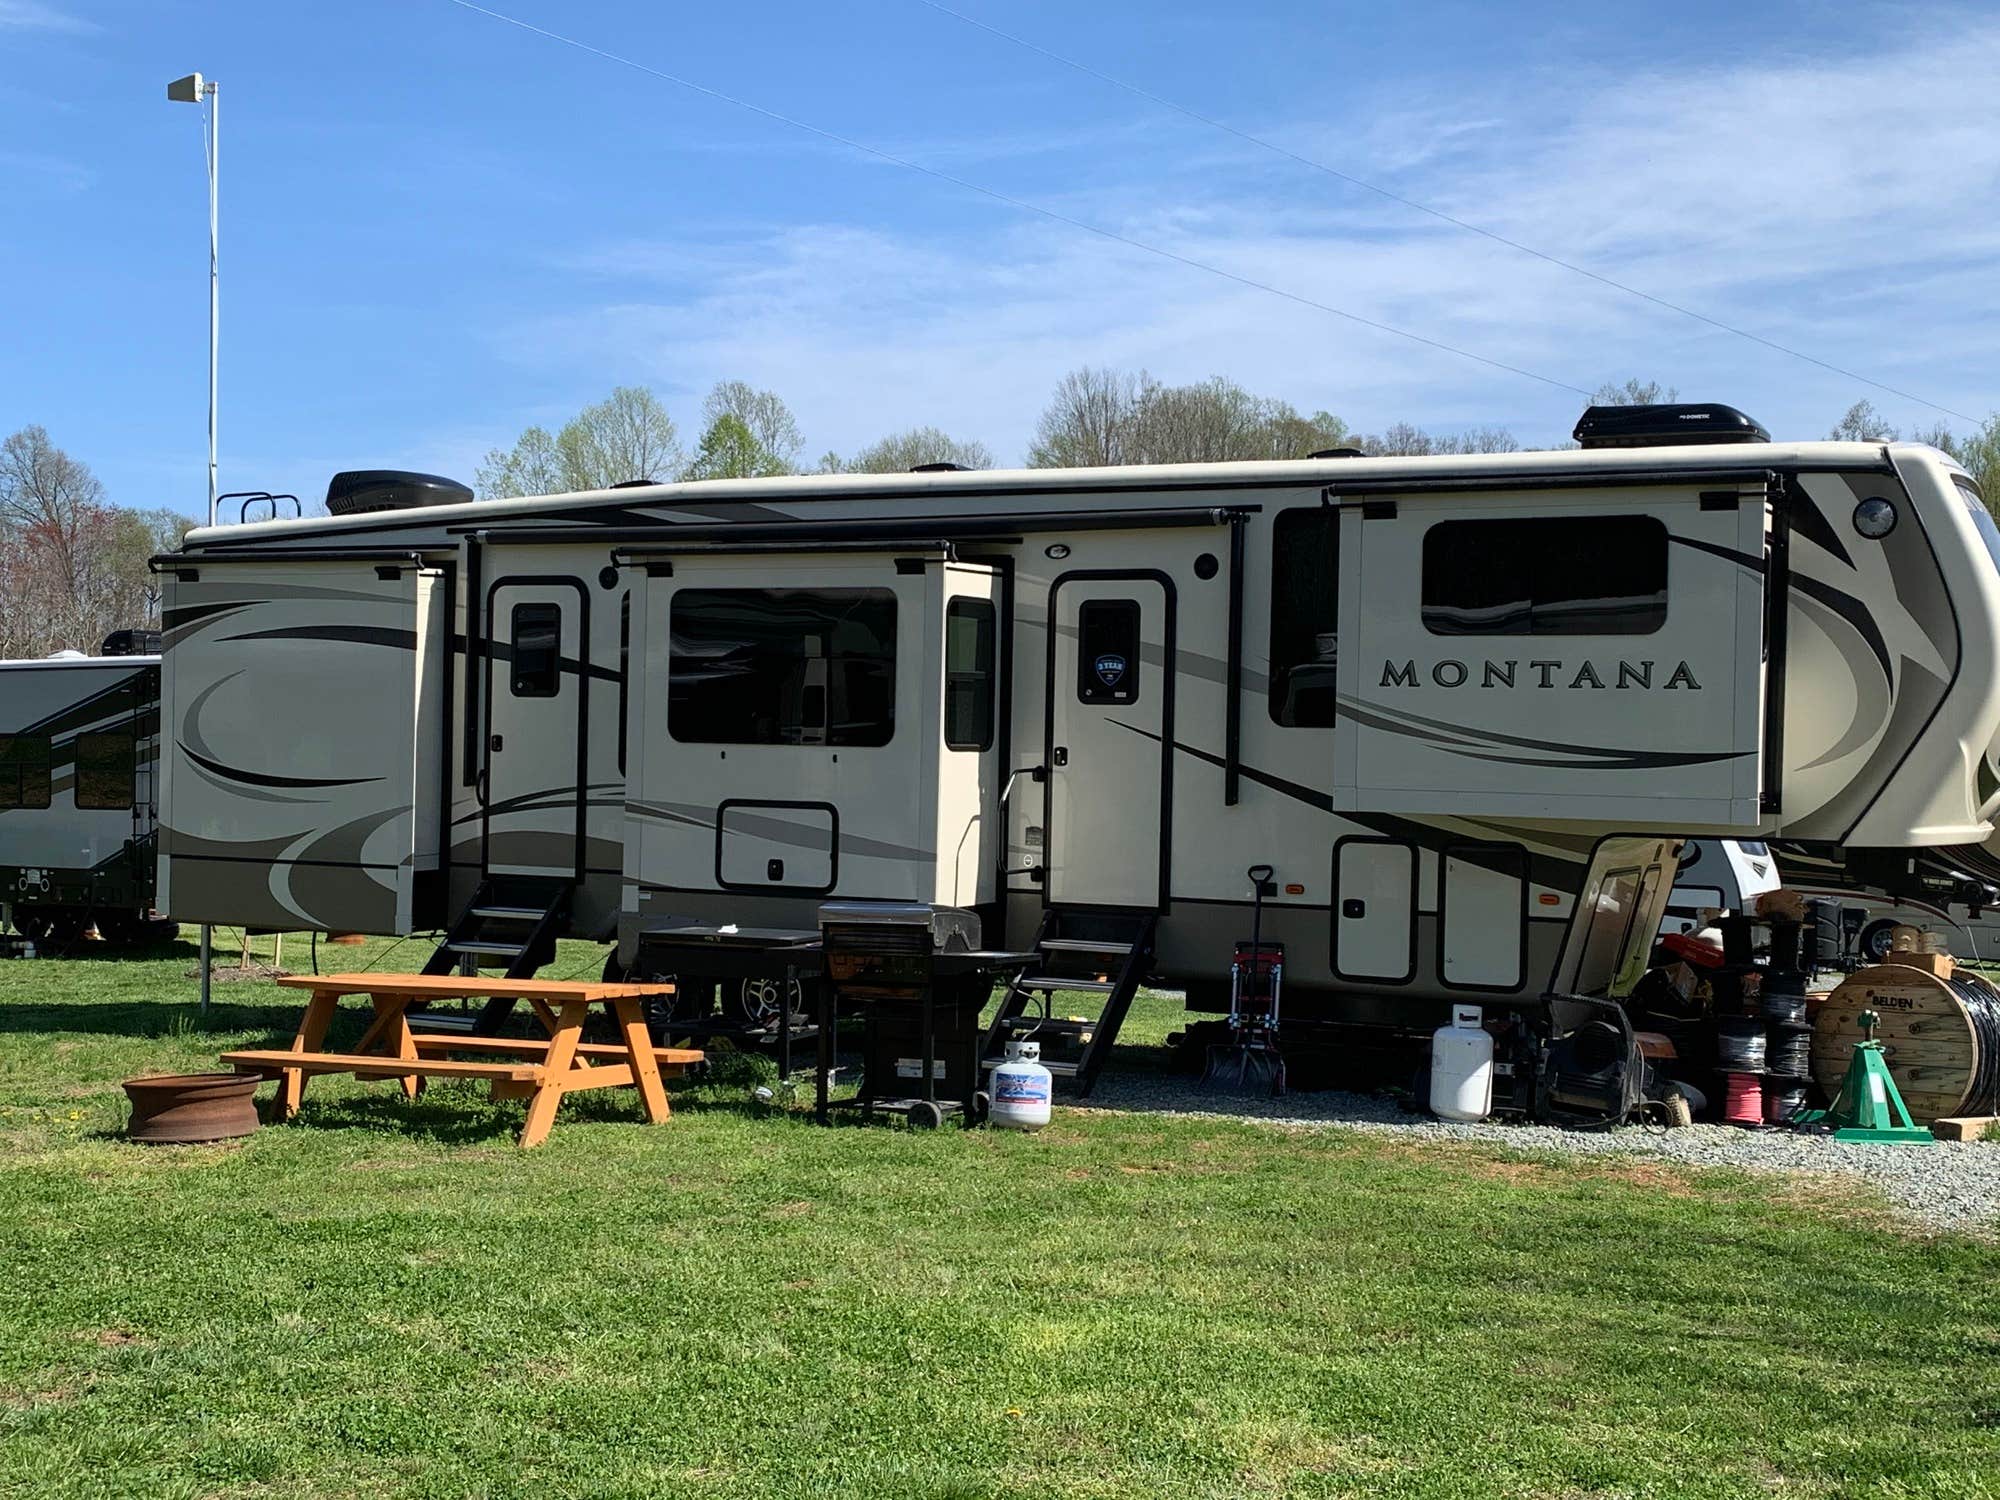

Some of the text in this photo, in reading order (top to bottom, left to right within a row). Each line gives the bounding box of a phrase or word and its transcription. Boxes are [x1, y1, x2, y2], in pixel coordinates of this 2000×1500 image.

[1104, 662, 1123, 670] YEAR
[1379, 659, 1702, 690] MONTANA
[1872, 996, 1913, 1009] BELDEN
